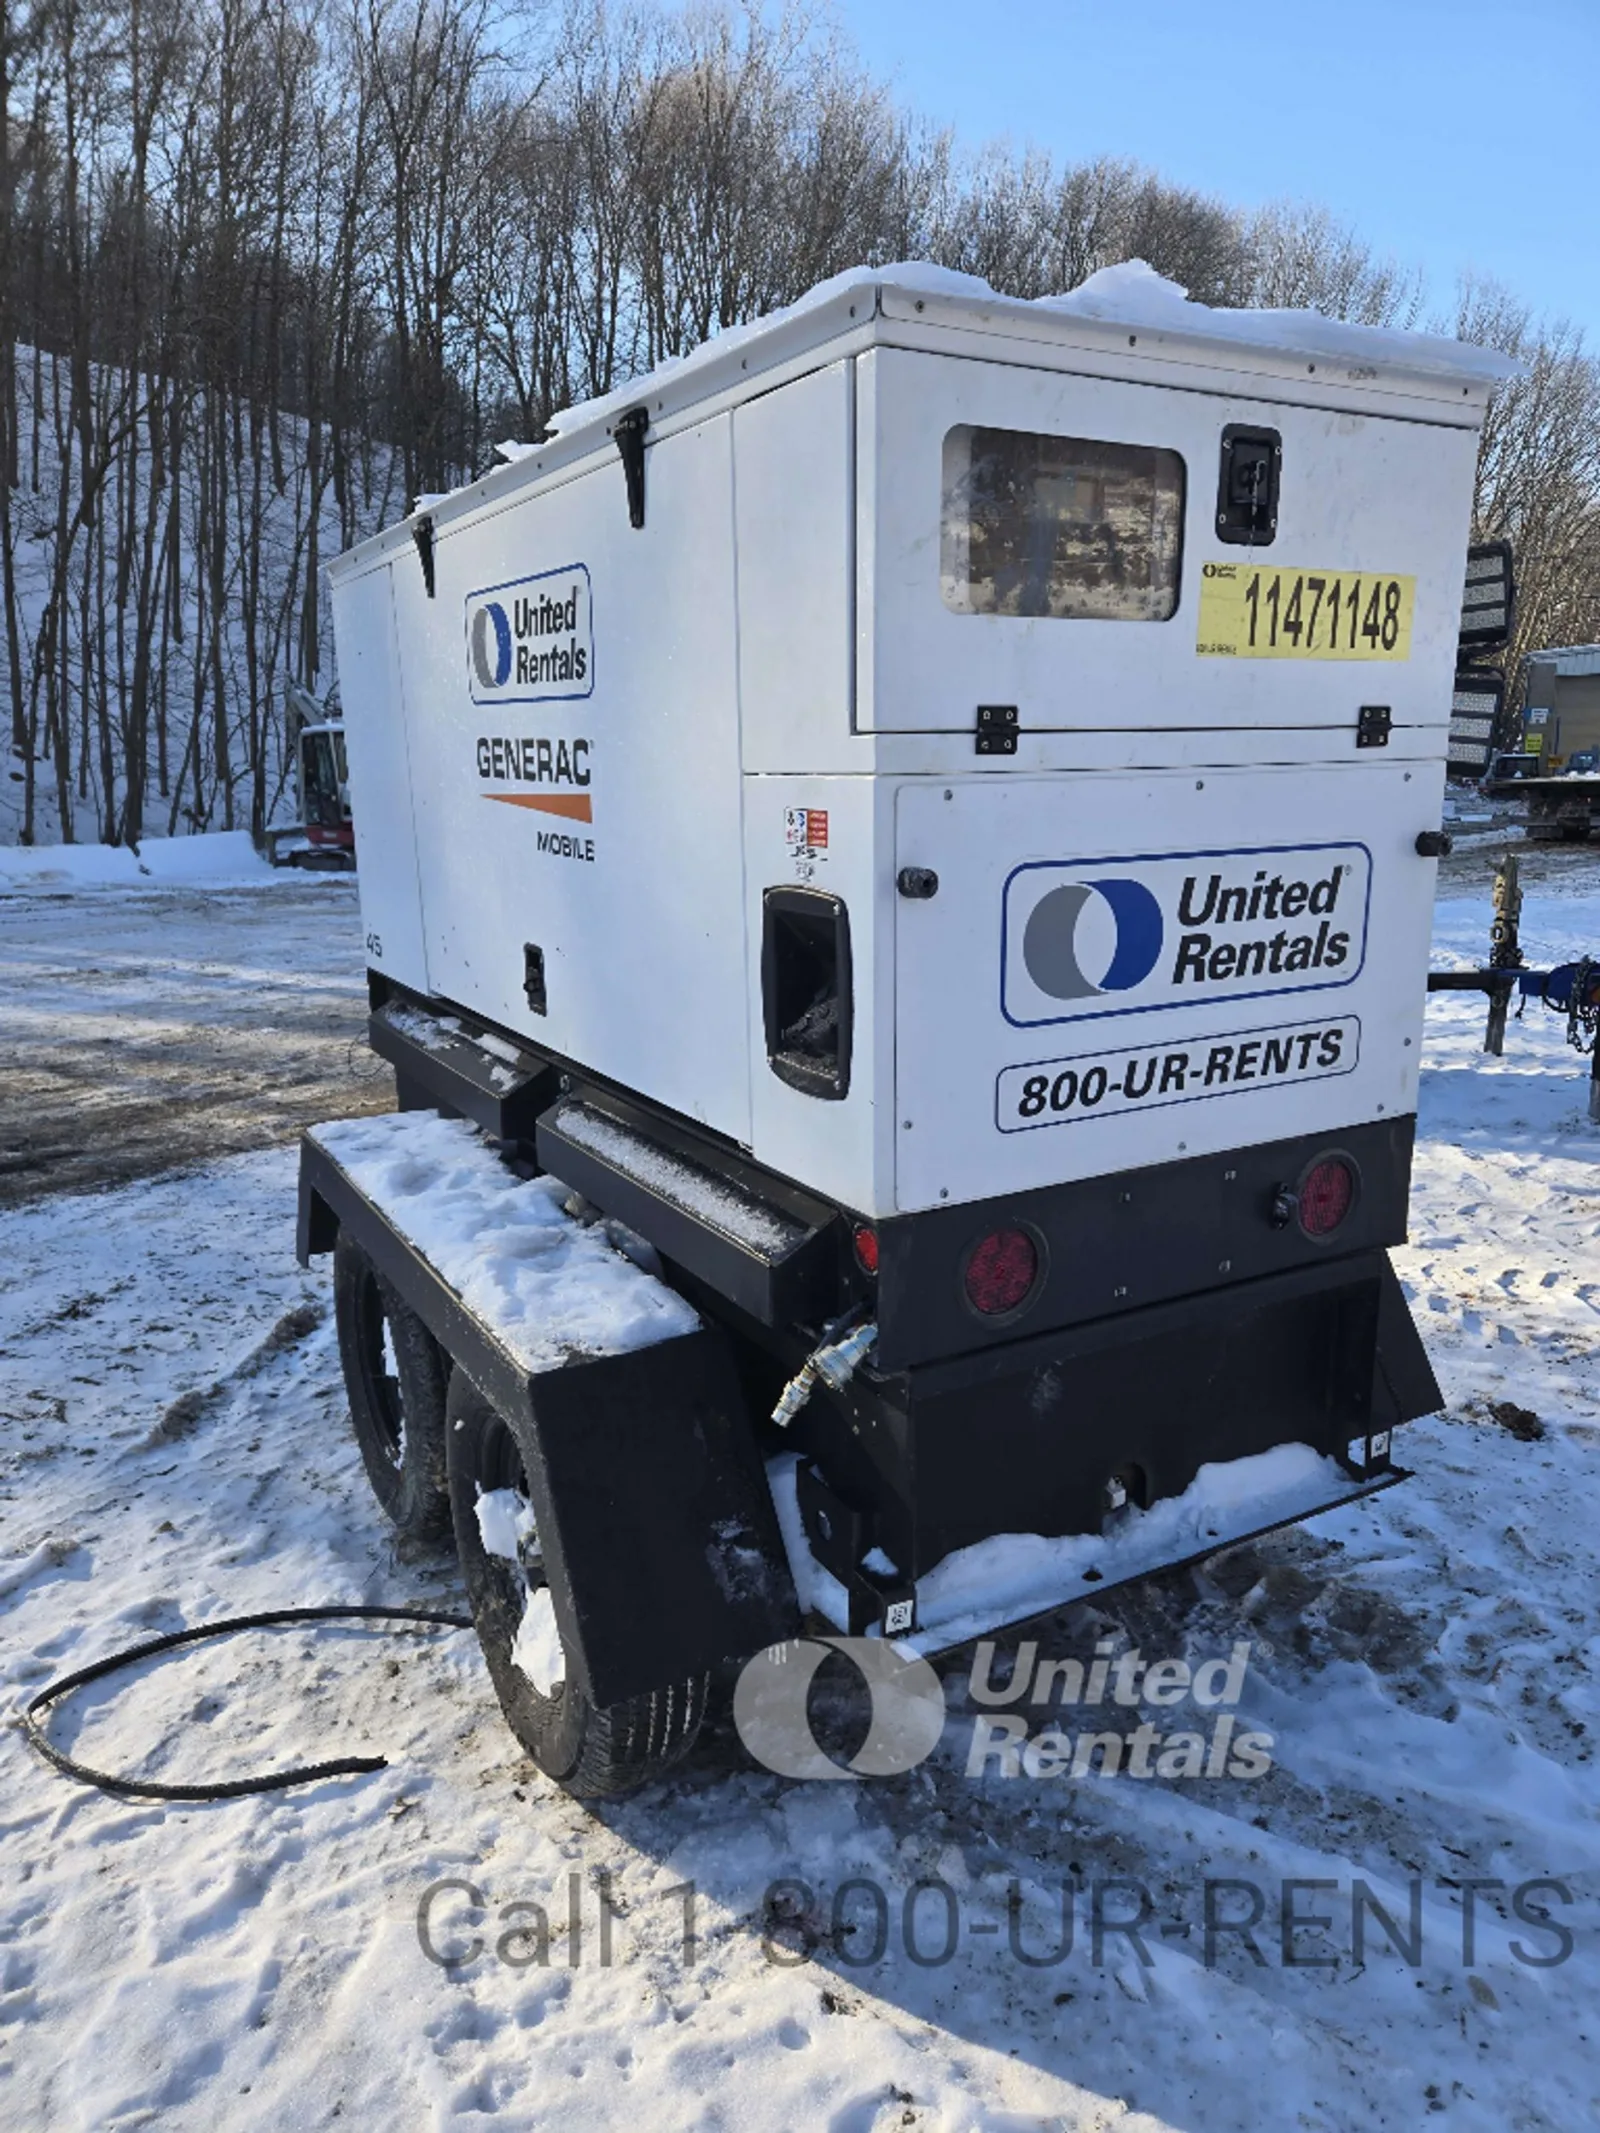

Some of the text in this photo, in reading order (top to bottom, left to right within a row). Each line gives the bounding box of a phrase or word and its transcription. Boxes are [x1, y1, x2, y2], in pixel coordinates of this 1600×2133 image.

[514, 585, 577, 640] United
[1246, 573, 1400, 650] 11471148
[516, 637, 587, 685] Rentals
[476, 737, 591, 787] GENERAC
[537, 831, 595, 862] MOBILE
[1177, 865, 1343, 927] United
[1171, 920, 1350, 985] Rentals
[1017, 1029, 1344, 1117] 800-UR-RENTS
